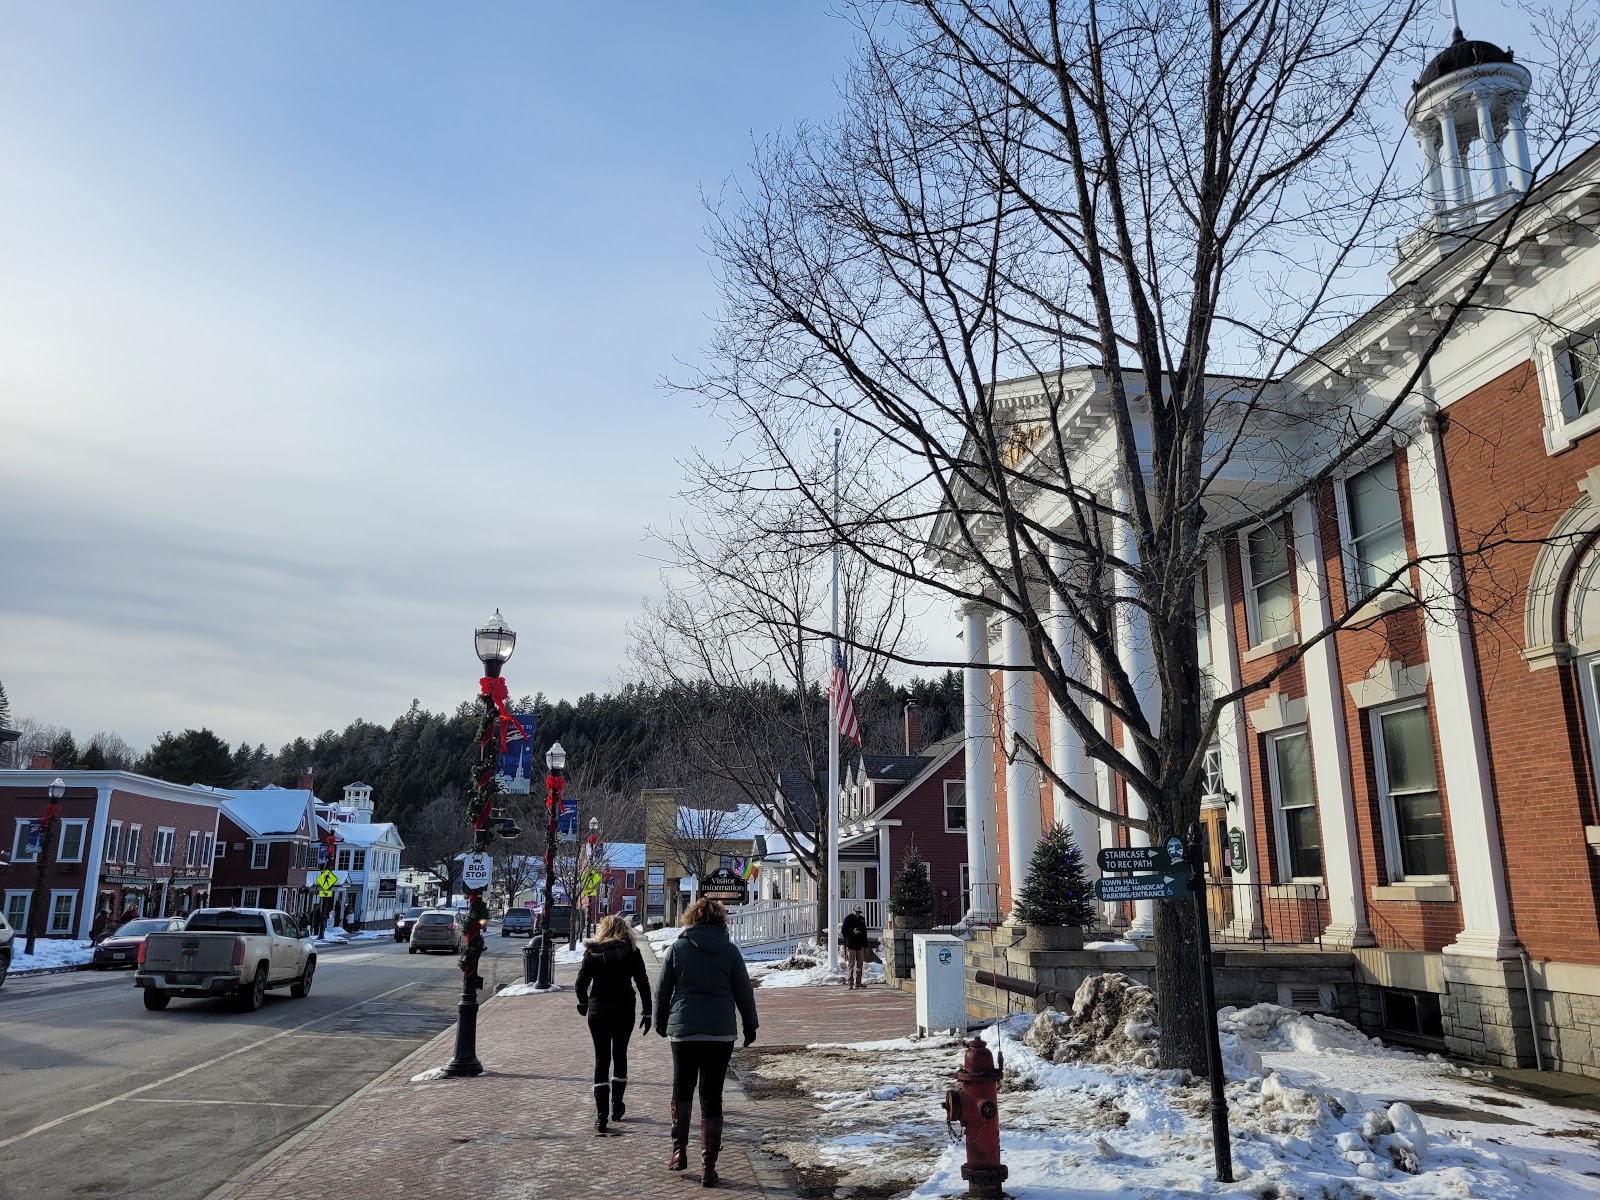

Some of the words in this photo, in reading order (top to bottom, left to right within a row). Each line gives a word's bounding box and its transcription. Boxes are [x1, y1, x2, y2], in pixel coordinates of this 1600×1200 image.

[1104, 850, 1145, 859] STAIRCASE
[1105, 861, 1116, 869] TO
[1117, 860, 1132, 868] REC
[1133, 860, 1152, 868] PATH
[1101, 885, 1130, 893] BUILDING
[1131, 883, 1164, 891] HANDICAP
[1102, 889, 1165, 899] PARKING/ENTRANCE
